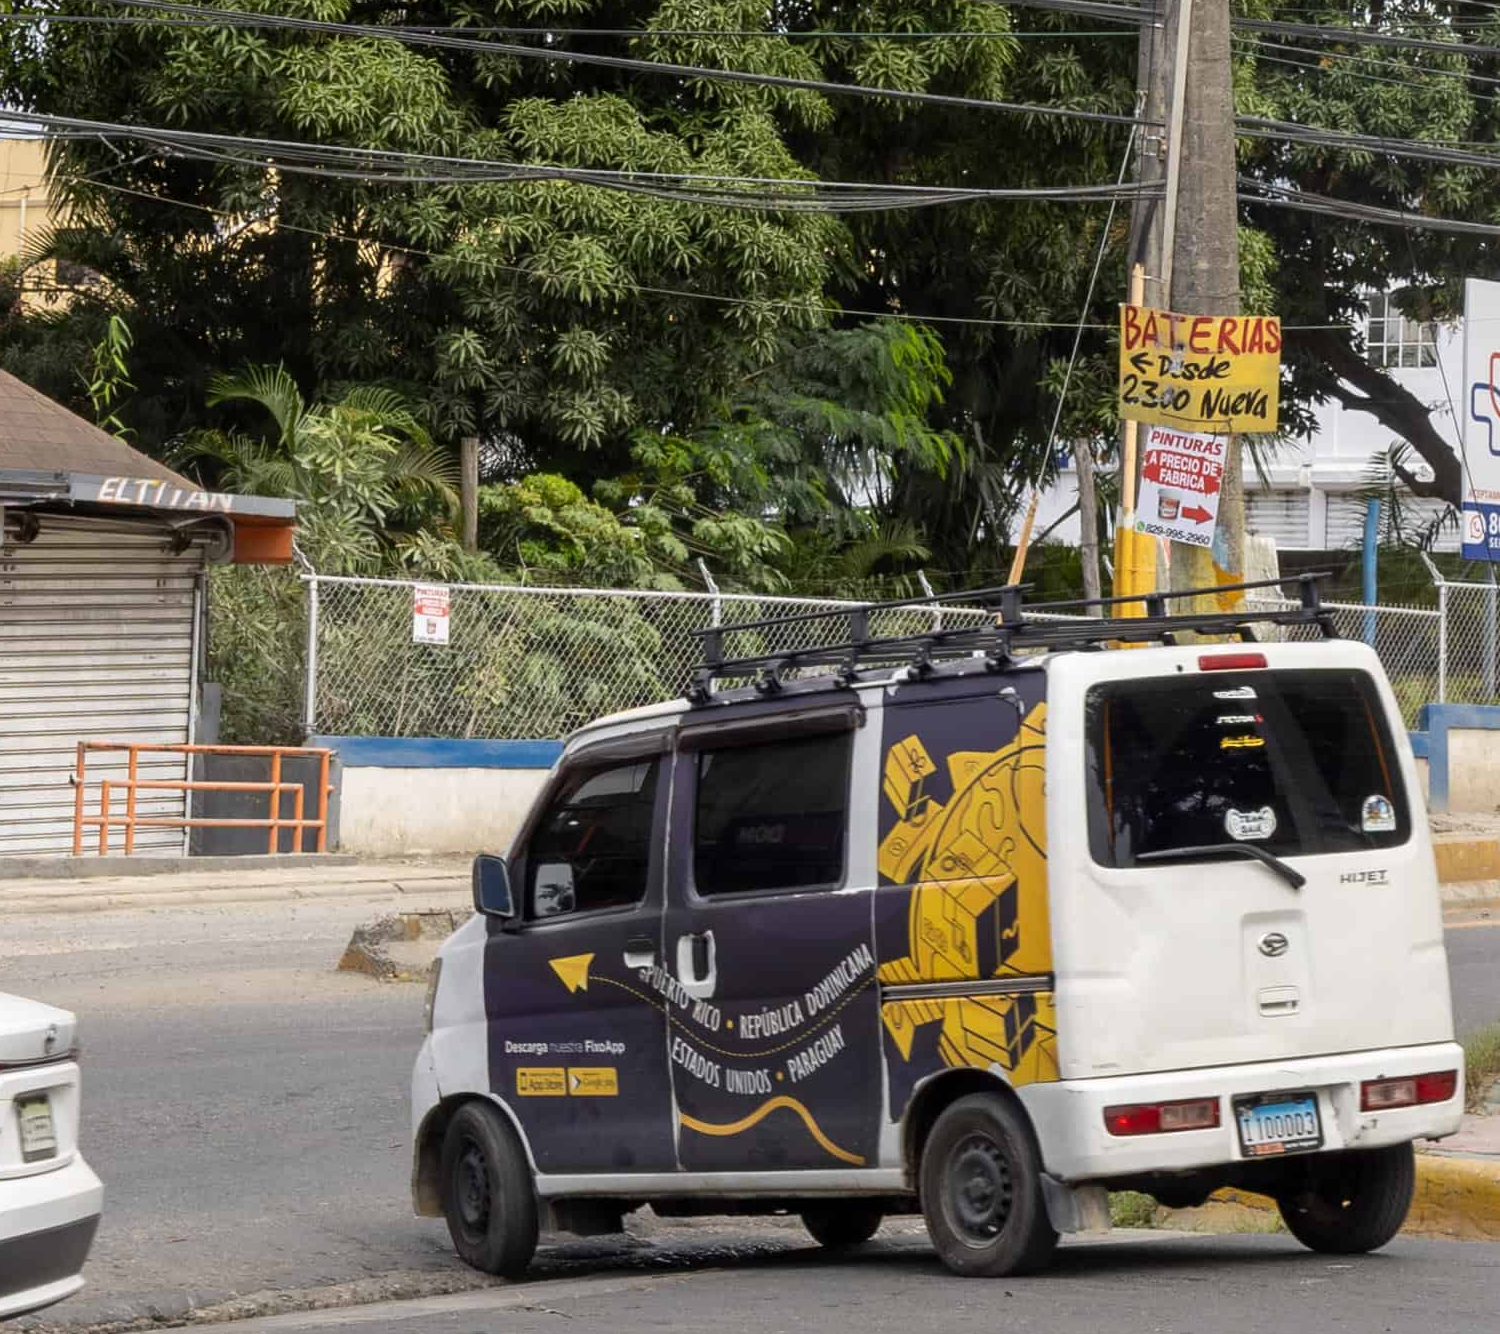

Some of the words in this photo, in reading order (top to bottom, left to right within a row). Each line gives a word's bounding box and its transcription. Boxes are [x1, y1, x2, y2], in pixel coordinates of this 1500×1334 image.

[1124, 305, 1282, 355] BATERIAS
[1200, 387, 1269, 419] Nueva
[1150, 430, 1223, 456] PINTURAS
[1149, 452, 1157, 466] A
[1159, 452, 1200, 473] PRECIO
[1202, 462, 1218, 477] DE
[1159, 468, 1205, 491] FABRICA
[1340, 869, 1388, 884] HIJET
[647, 965, 690, 1010] PUERTO
[739, 1000, 805, 1040] REPÚBLICA
[804, 942, 876, 1017] DOMINICANA
[504, 1039, 549, 1056] Descarga
[671, 1036, 721, 1088] ESTADOS
[726, 1068, 773, 1095] UNIDOS
[786, 1023, 847, 1084] PARAGUAY
